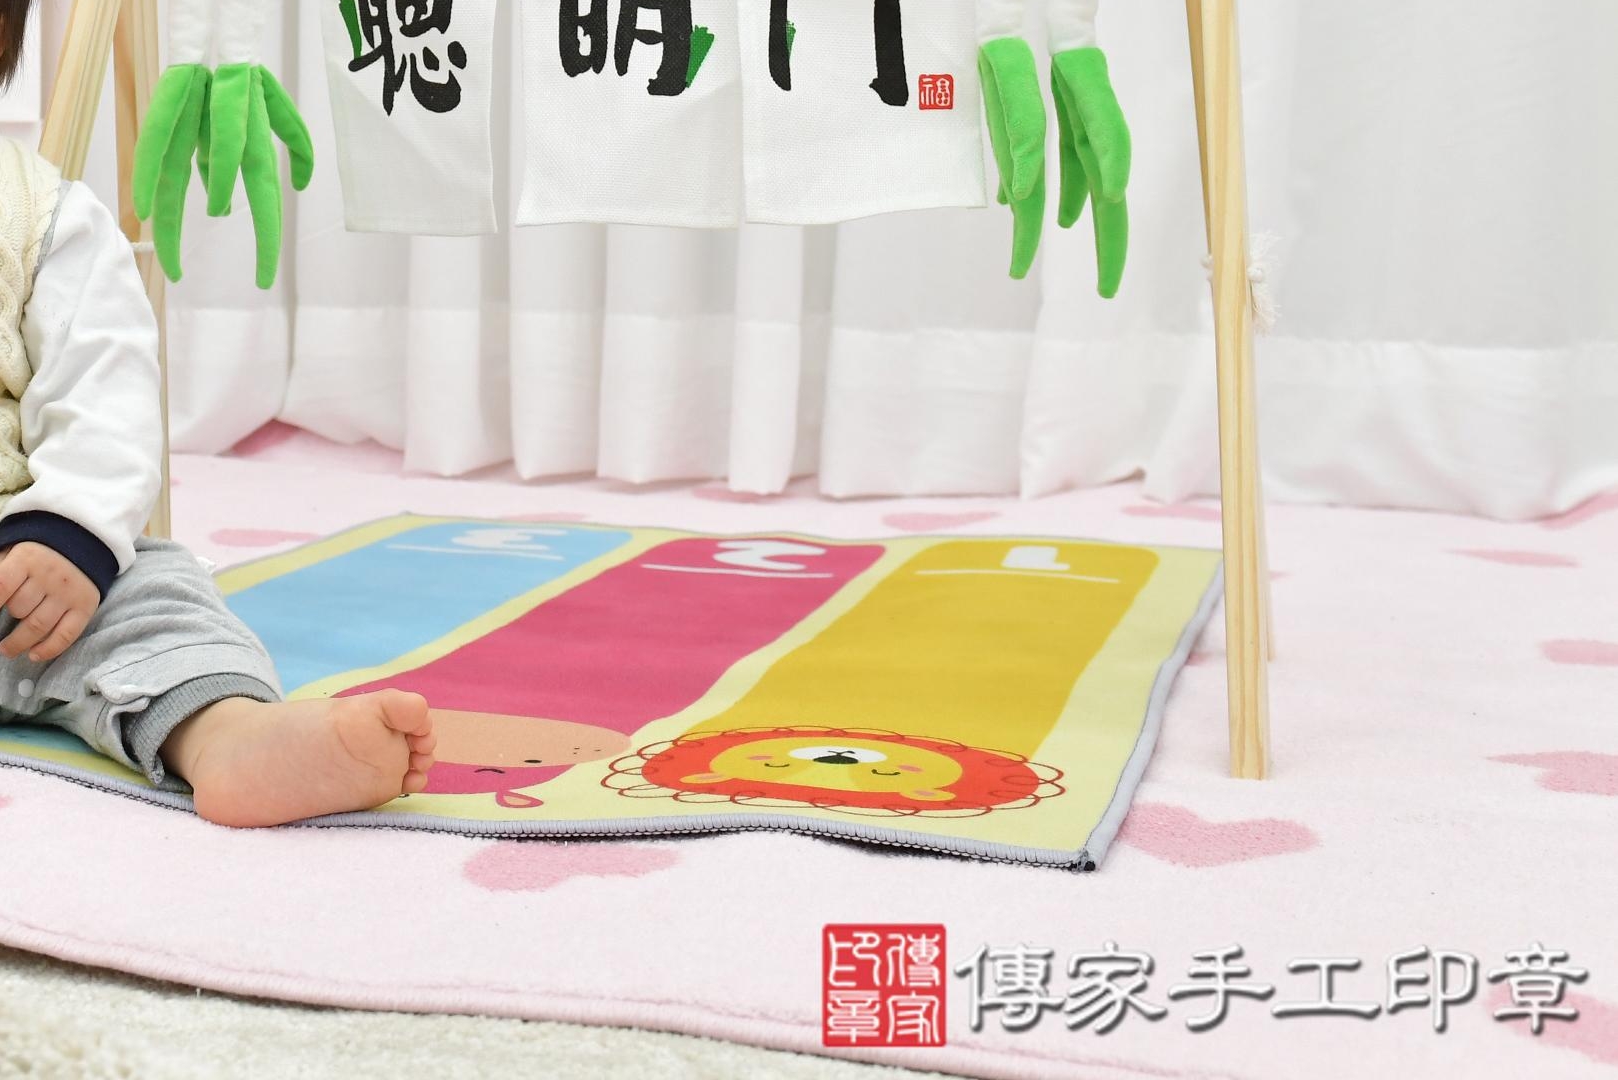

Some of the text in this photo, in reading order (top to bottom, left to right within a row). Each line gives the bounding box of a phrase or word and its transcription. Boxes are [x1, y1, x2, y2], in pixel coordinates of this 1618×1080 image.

[918, 73, 954, 110] 福
[712, 540, 828, 571] 2
[1001, 545, 1071, 571] 1
